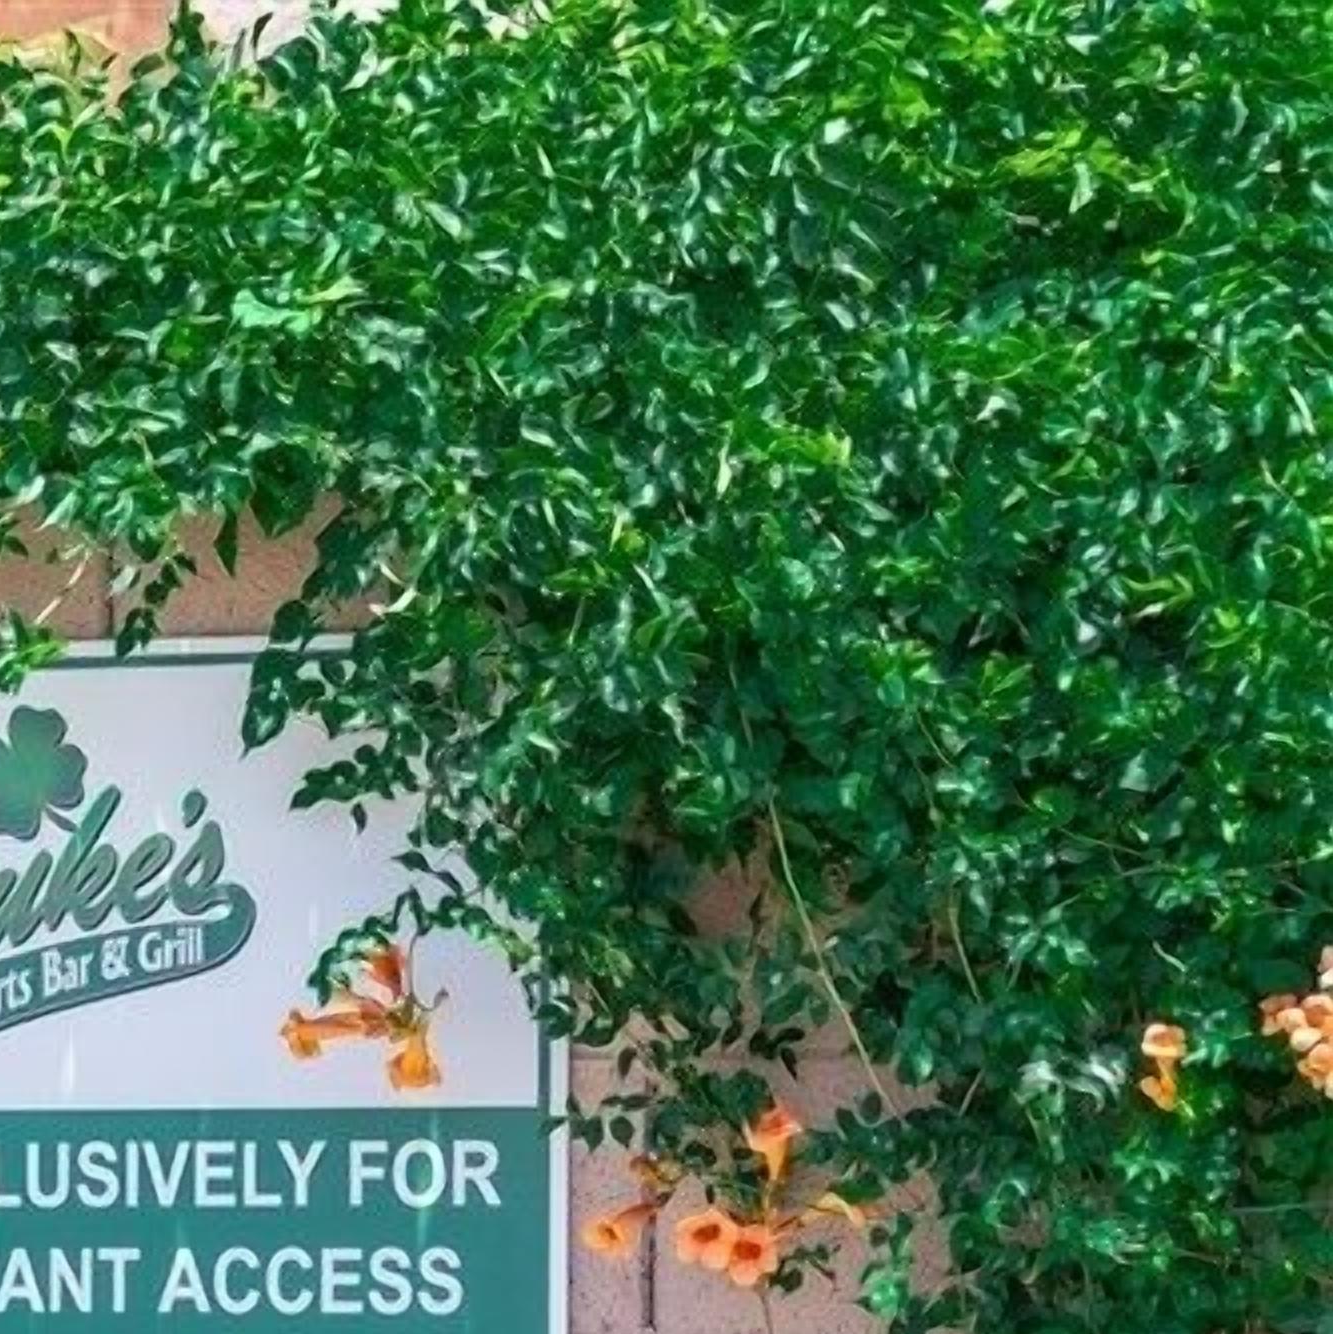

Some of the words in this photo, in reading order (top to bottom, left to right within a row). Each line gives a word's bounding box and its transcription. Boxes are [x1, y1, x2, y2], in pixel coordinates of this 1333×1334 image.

[41, 947, 93, 997] Bar
[100, 935, 130, 981] &
[138, 926, 204, 970] Grill
[348, 1138, 502, 1208] FOR
[158, 1246, 464, 1315] ACCESS
